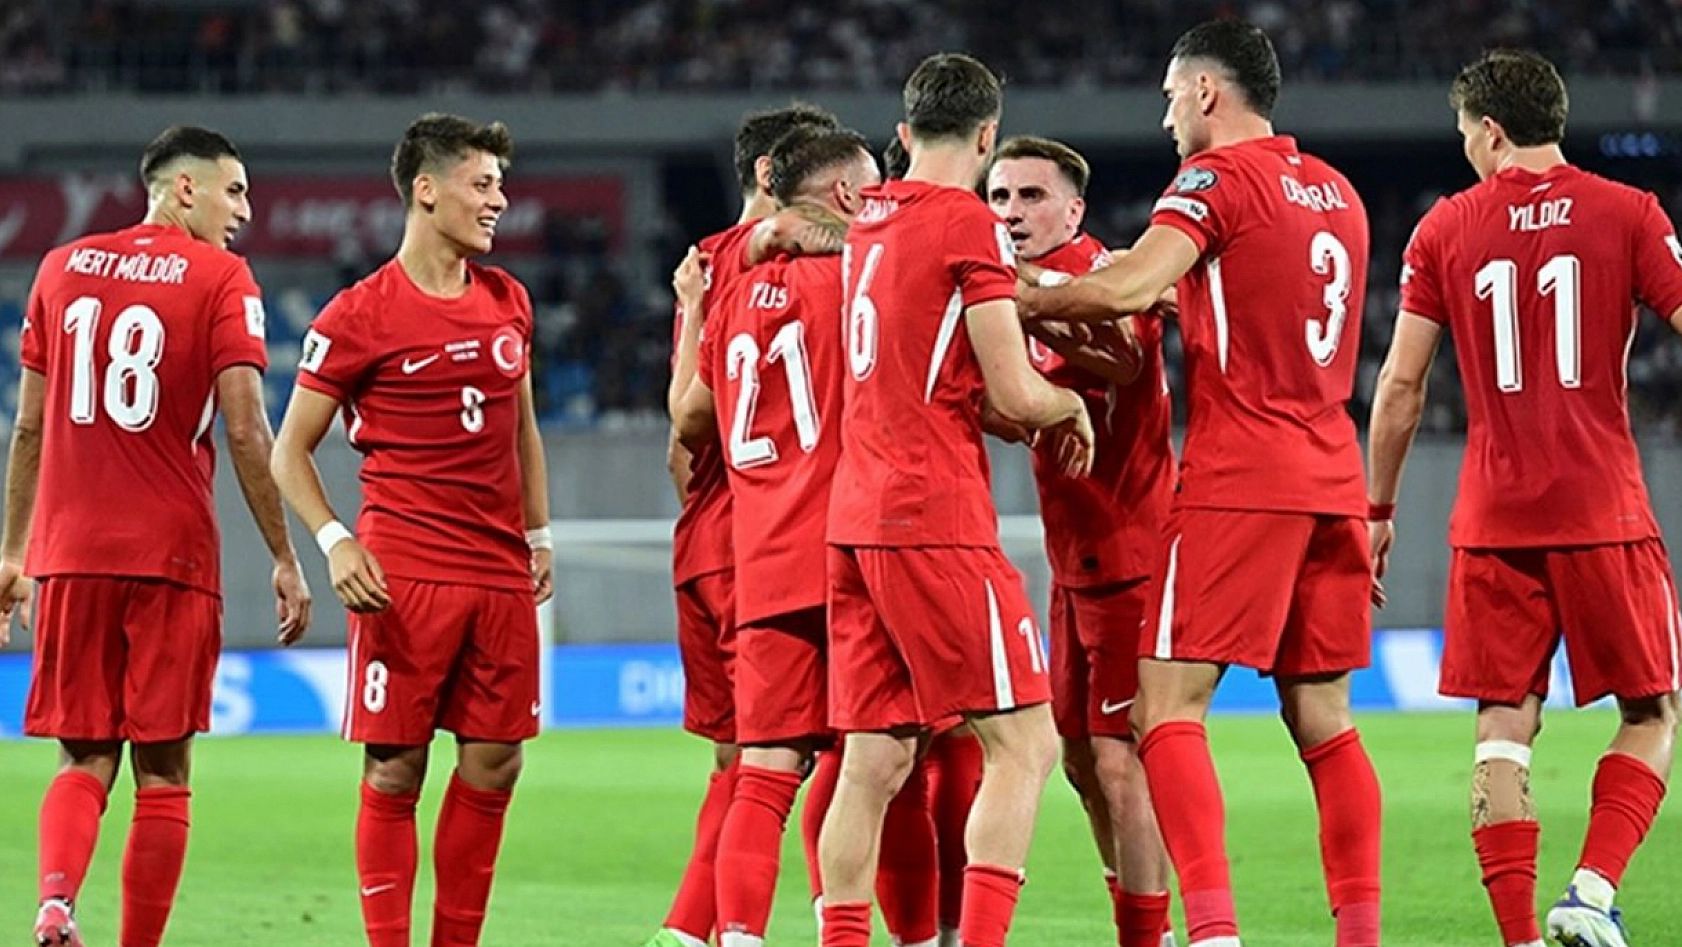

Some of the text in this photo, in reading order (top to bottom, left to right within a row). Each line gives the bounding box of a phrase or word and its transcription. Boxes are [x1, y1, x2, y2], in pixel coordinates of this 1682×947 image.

[1507, 198, 1573, 231] YILDIZ
[65, 248, 188, 283] MERT MÜLDÜR
[1305, 231, 1353, 367] 3
[64, 296, 165, 434] 18
[1474, 254, 1582, 393] 11
[460, 385, 486, 433] 8
[727, 320, 822, 470] 21
[362, 660, 391, 715] 8
